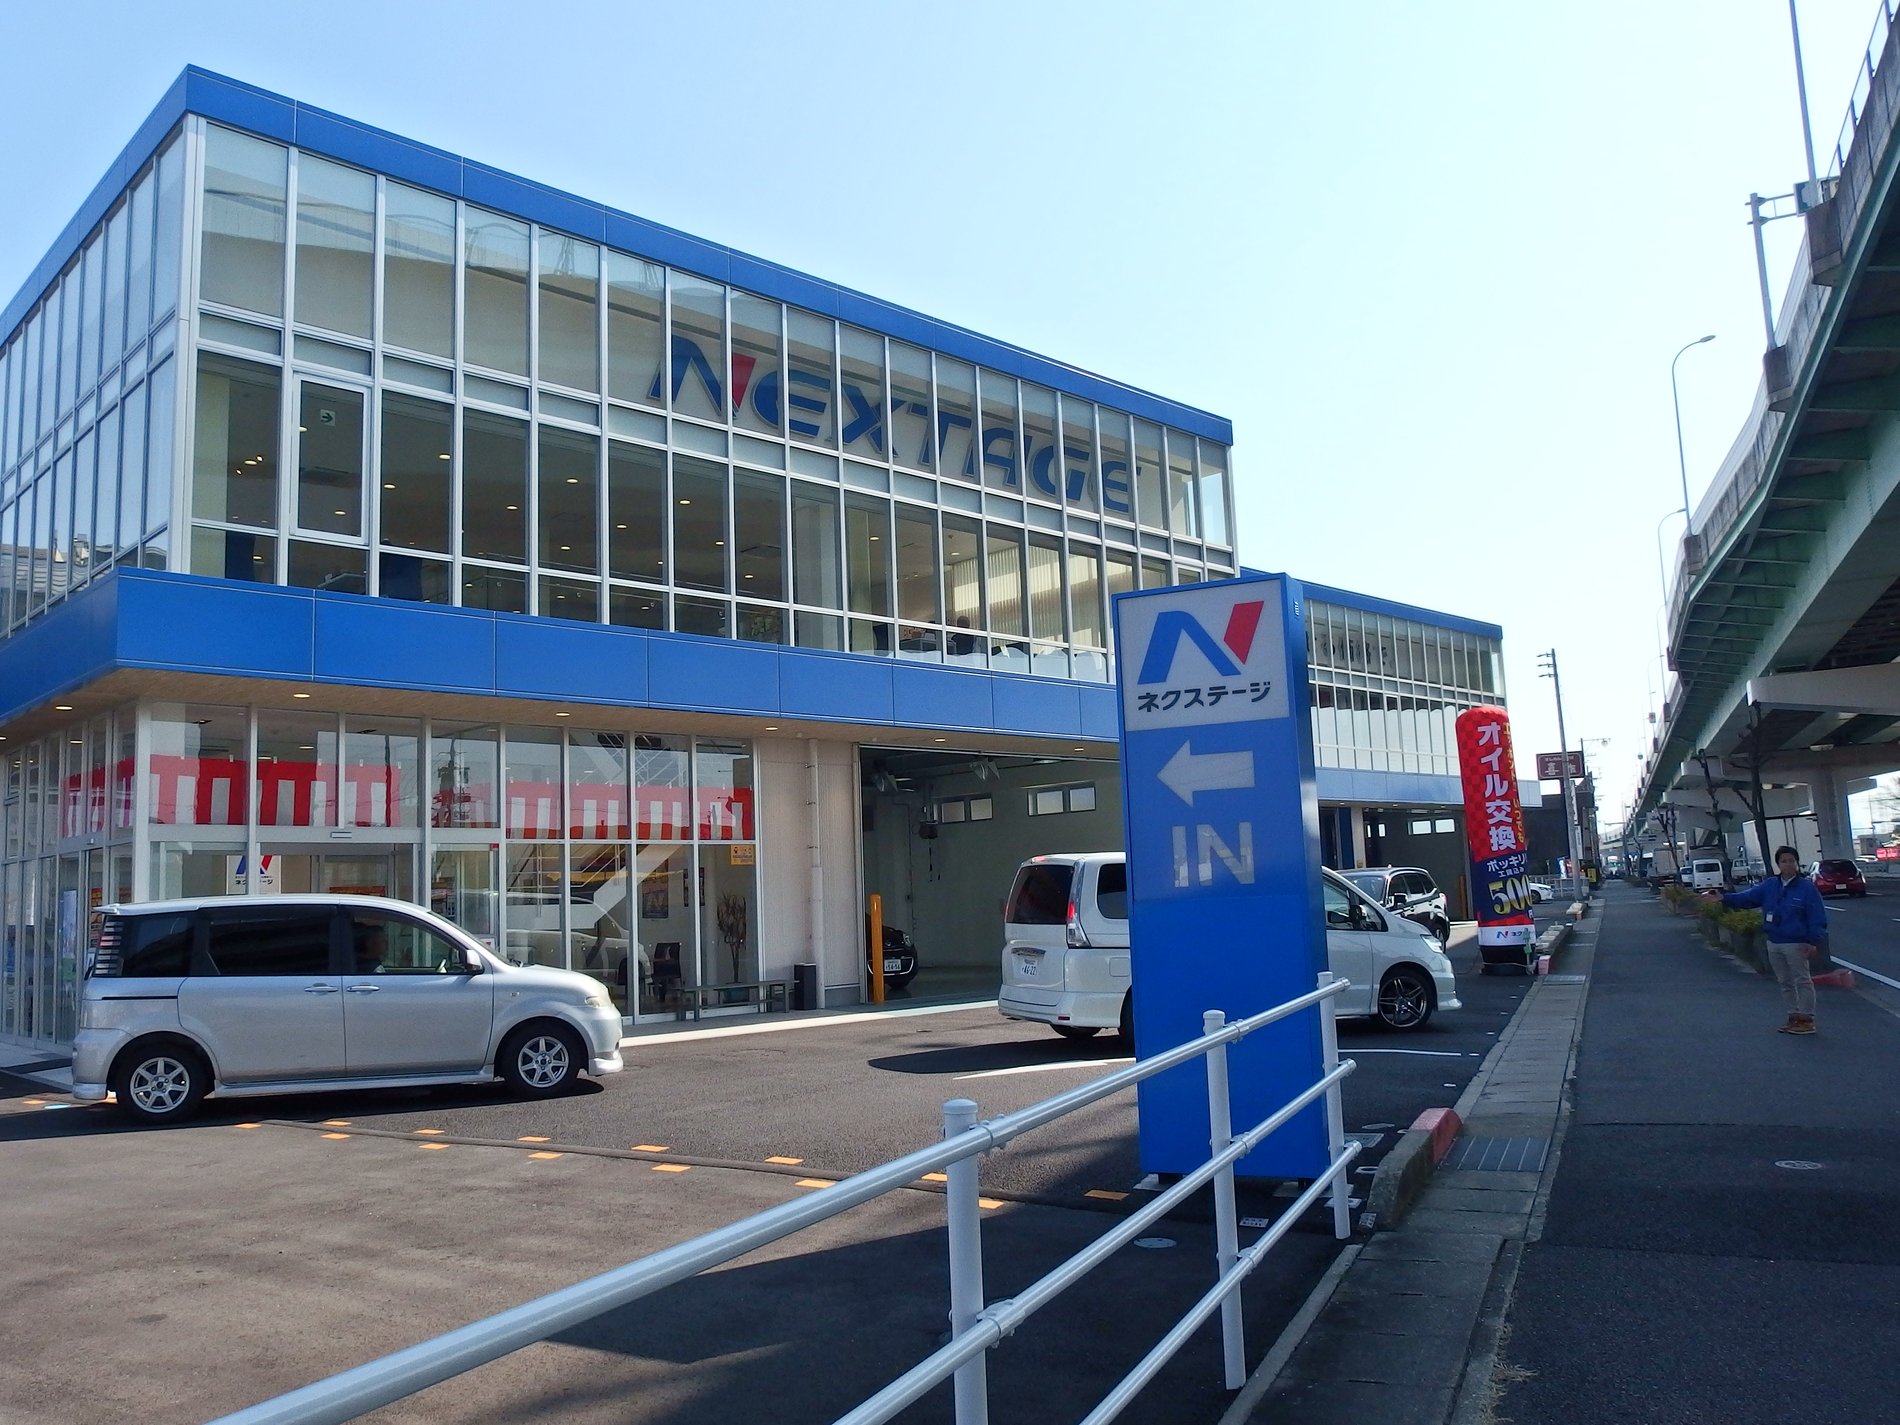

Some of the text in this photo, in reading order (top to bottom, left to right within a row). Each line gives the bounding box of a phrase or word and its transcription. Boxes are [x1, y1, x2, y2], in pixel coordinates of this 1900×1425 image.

[646, 334, 1142, 513] NEXTAGE
[1137, 681, 1271, 713] ネクステージ
[1477, 721, 1517, 852] オイル交換
[1171, 820, 1255, 888] IN
